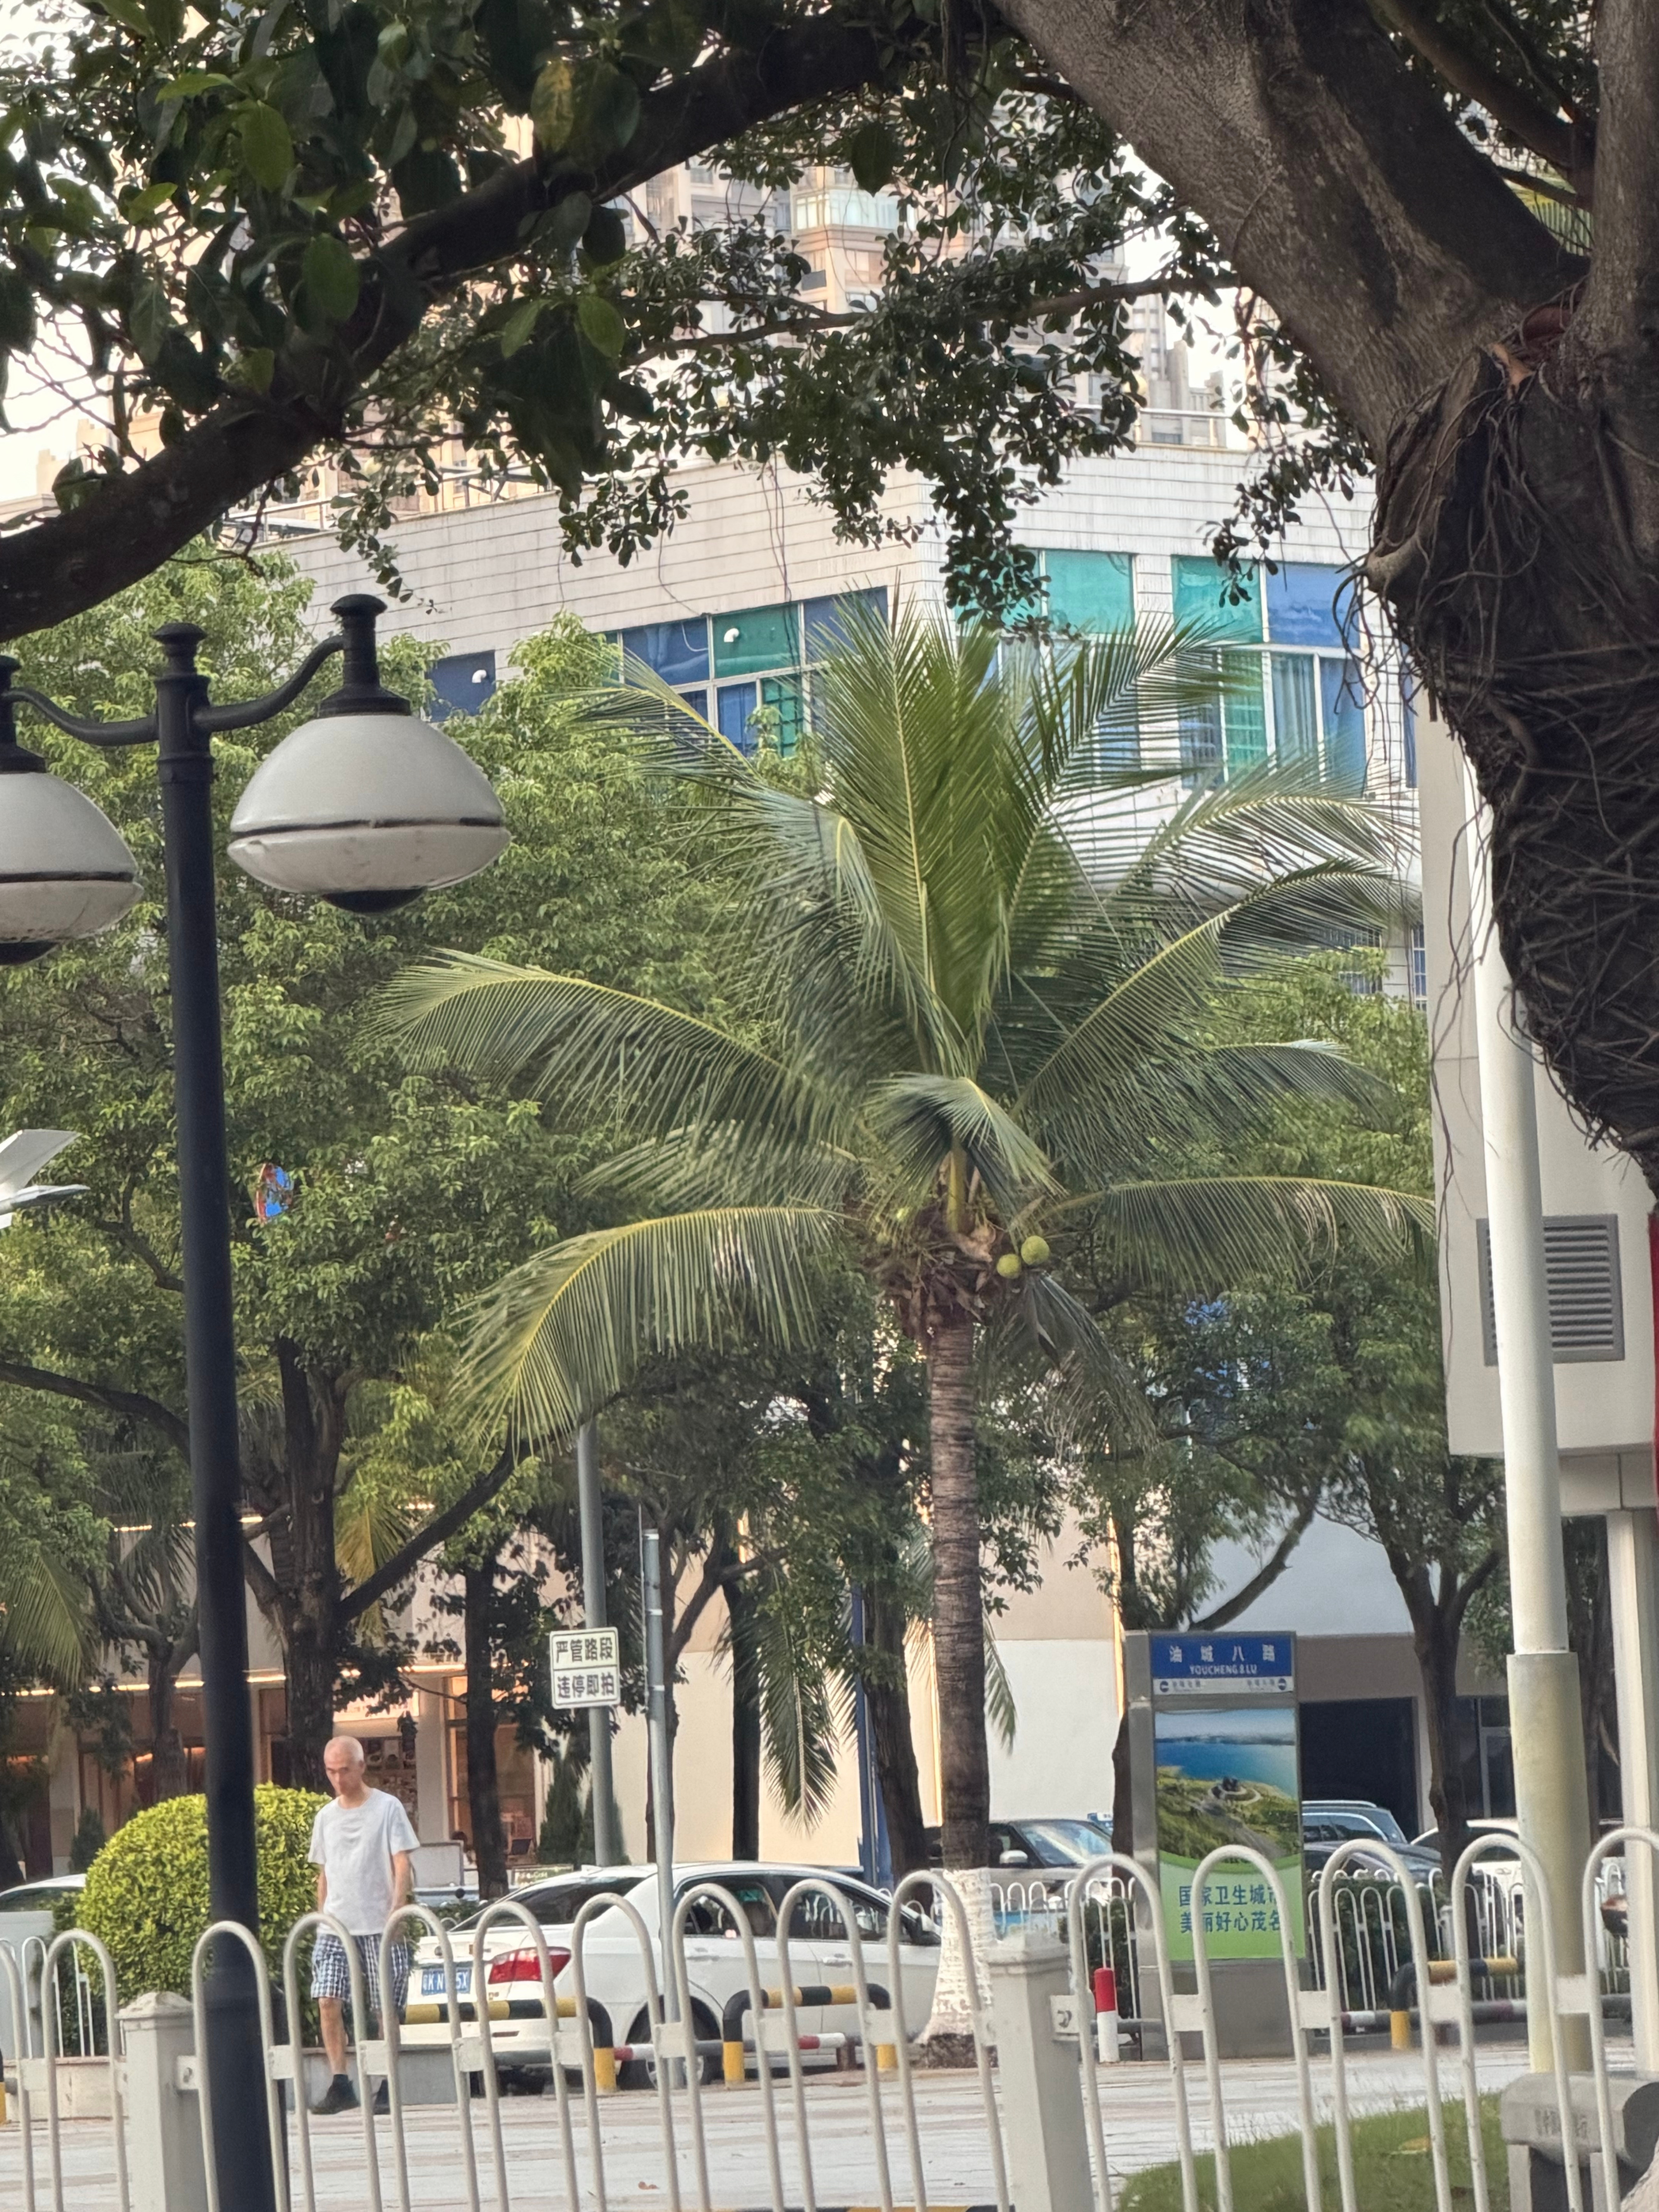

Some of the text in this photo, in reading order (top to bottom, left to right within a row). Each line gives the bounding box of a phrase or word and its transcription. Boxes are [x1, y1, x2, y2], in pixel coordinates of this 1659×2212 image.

[556, 1637, 613, 1663] 严管路段
[1169, 1644, 1275, 1663] 油城八路
[557, 1672, 615, 1698] 违停即拍
[423, 1971, 469, 1990] KN5X
